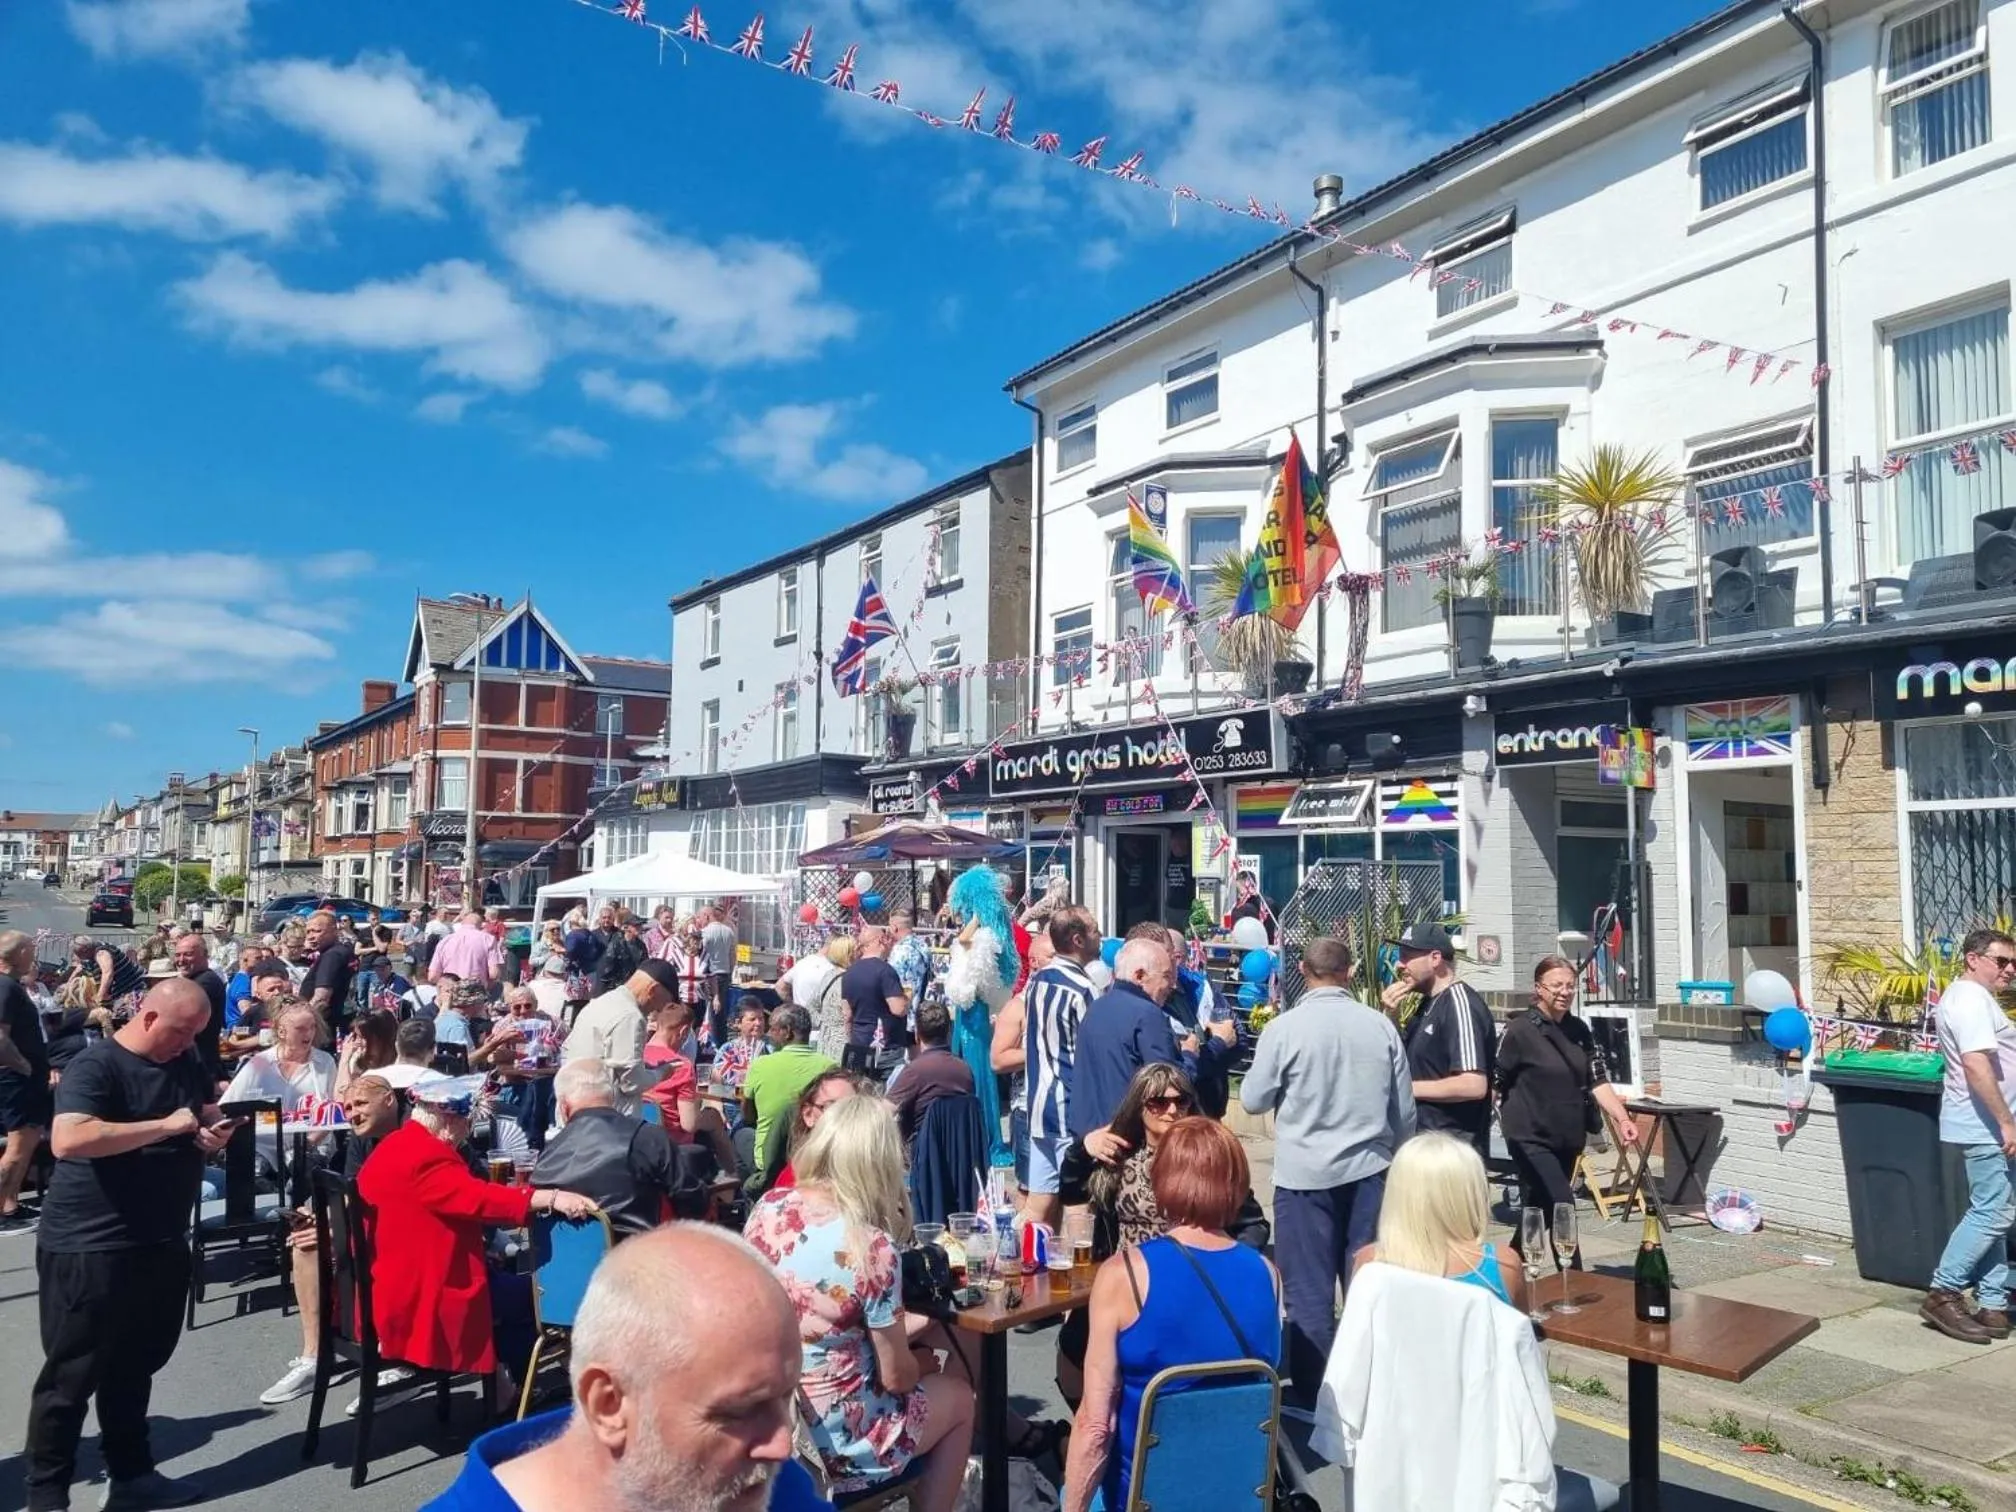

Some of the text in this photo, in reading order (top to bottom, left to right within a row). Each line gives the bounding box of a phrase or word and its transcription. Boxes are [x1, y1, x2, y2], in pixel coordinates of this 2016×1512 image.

[1497, 724, 1601, 754] entranc
[996, 727, 1186, 783] mardi gras hotel
[1194, 750, 1267, 771] 01253 283633
[885, 784, 912, 798] rooms
[1299, 799, 1326, 810] free
[423, 819, 468, 835] Moore
